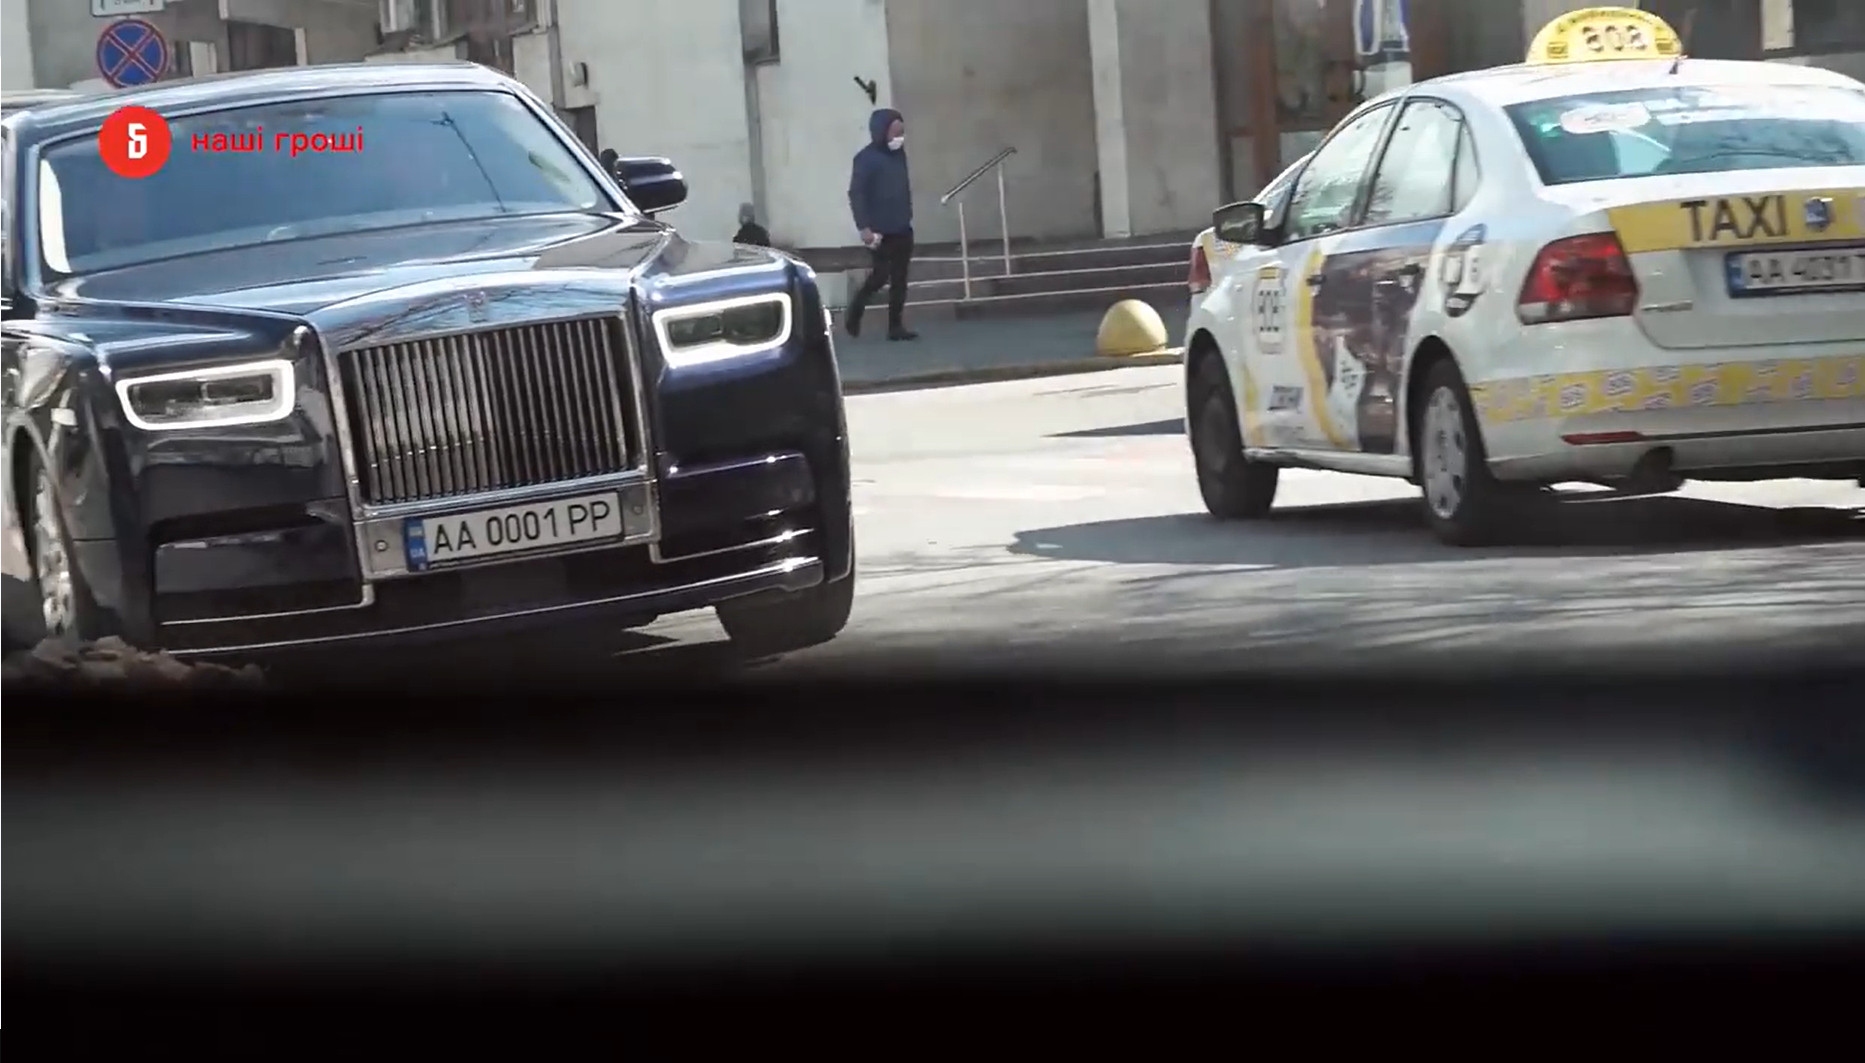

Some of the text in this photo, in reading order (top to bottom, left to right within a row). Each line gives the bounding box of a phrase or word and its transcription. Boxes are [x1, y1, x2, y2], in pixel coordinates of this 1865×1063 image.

[1680, 195, 1789, 242] TAXI
[433, 500, 610, 555] AA 0001 PP
